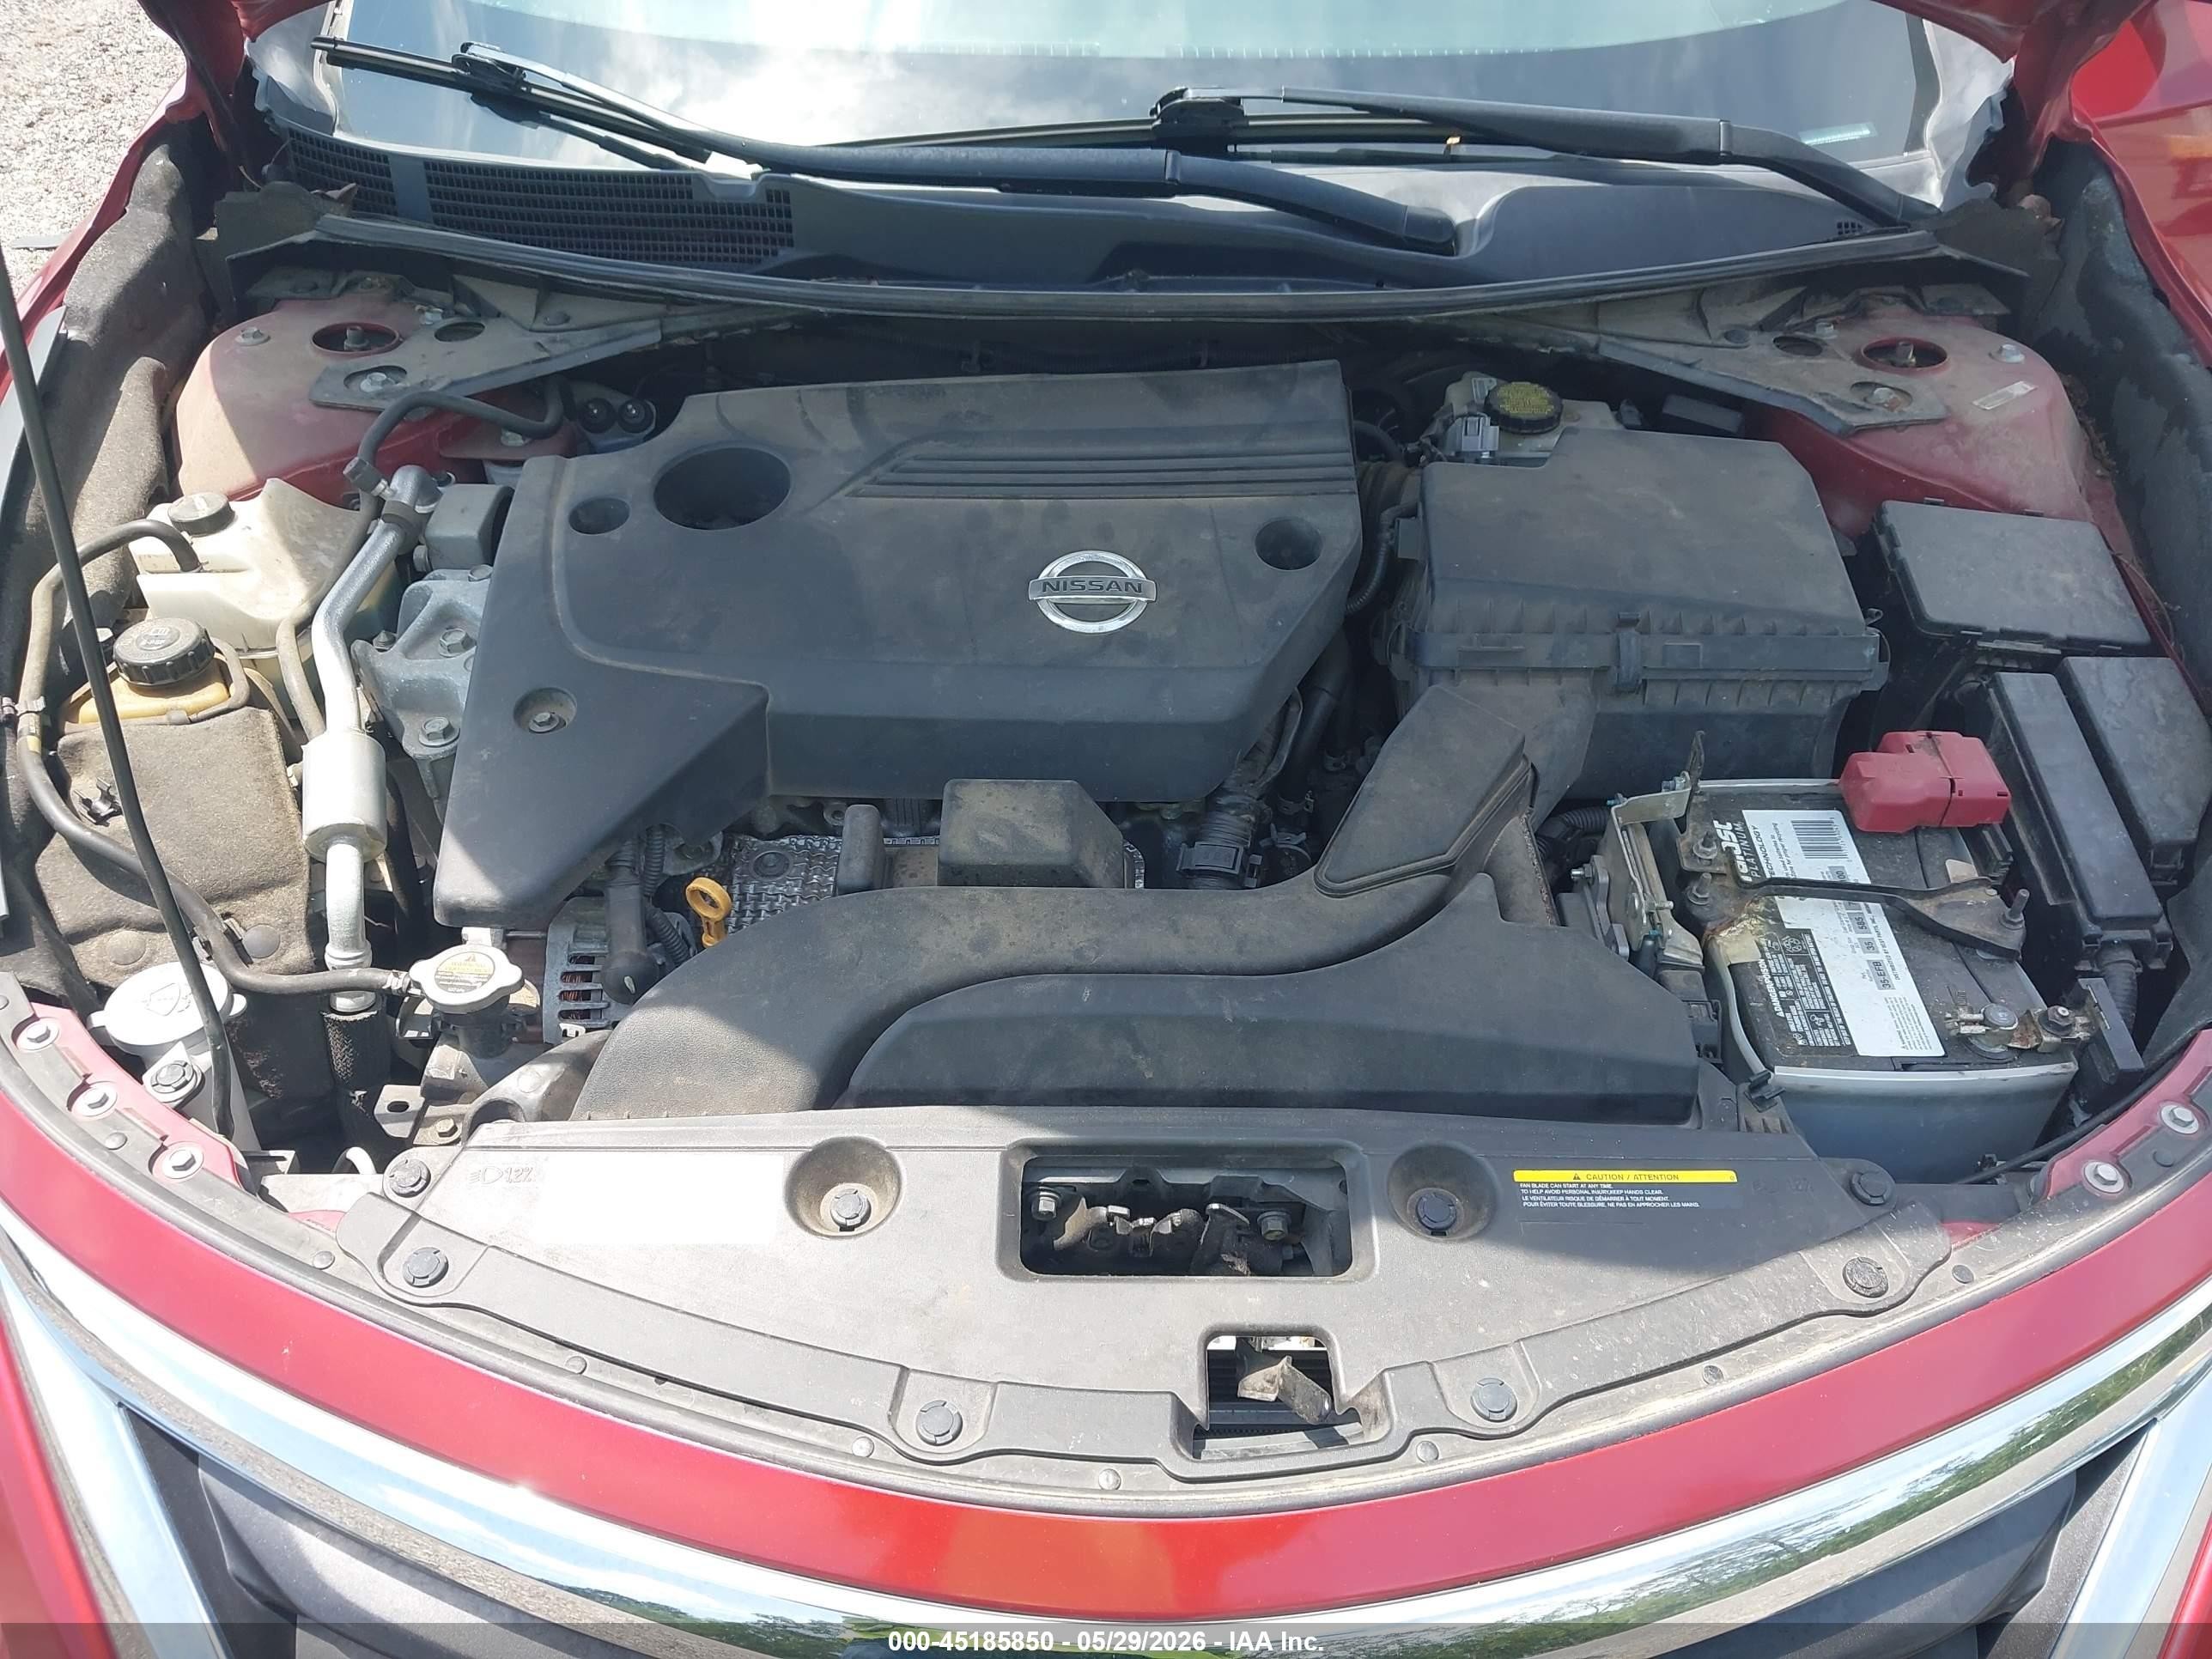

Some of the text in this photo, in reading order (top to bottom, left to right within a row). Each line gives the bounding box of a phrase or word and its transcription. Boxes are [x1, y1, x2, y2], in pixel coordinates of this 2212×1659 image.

[1042, 580, 1143, 593] NISSAN
[1735, 822, 1760, 877] PLATINUM
[1854, 916, 1867, 929] 585
[1865, 941, 1875, 950] 35
[1873, 961, 1891, 988] 35-EFB
